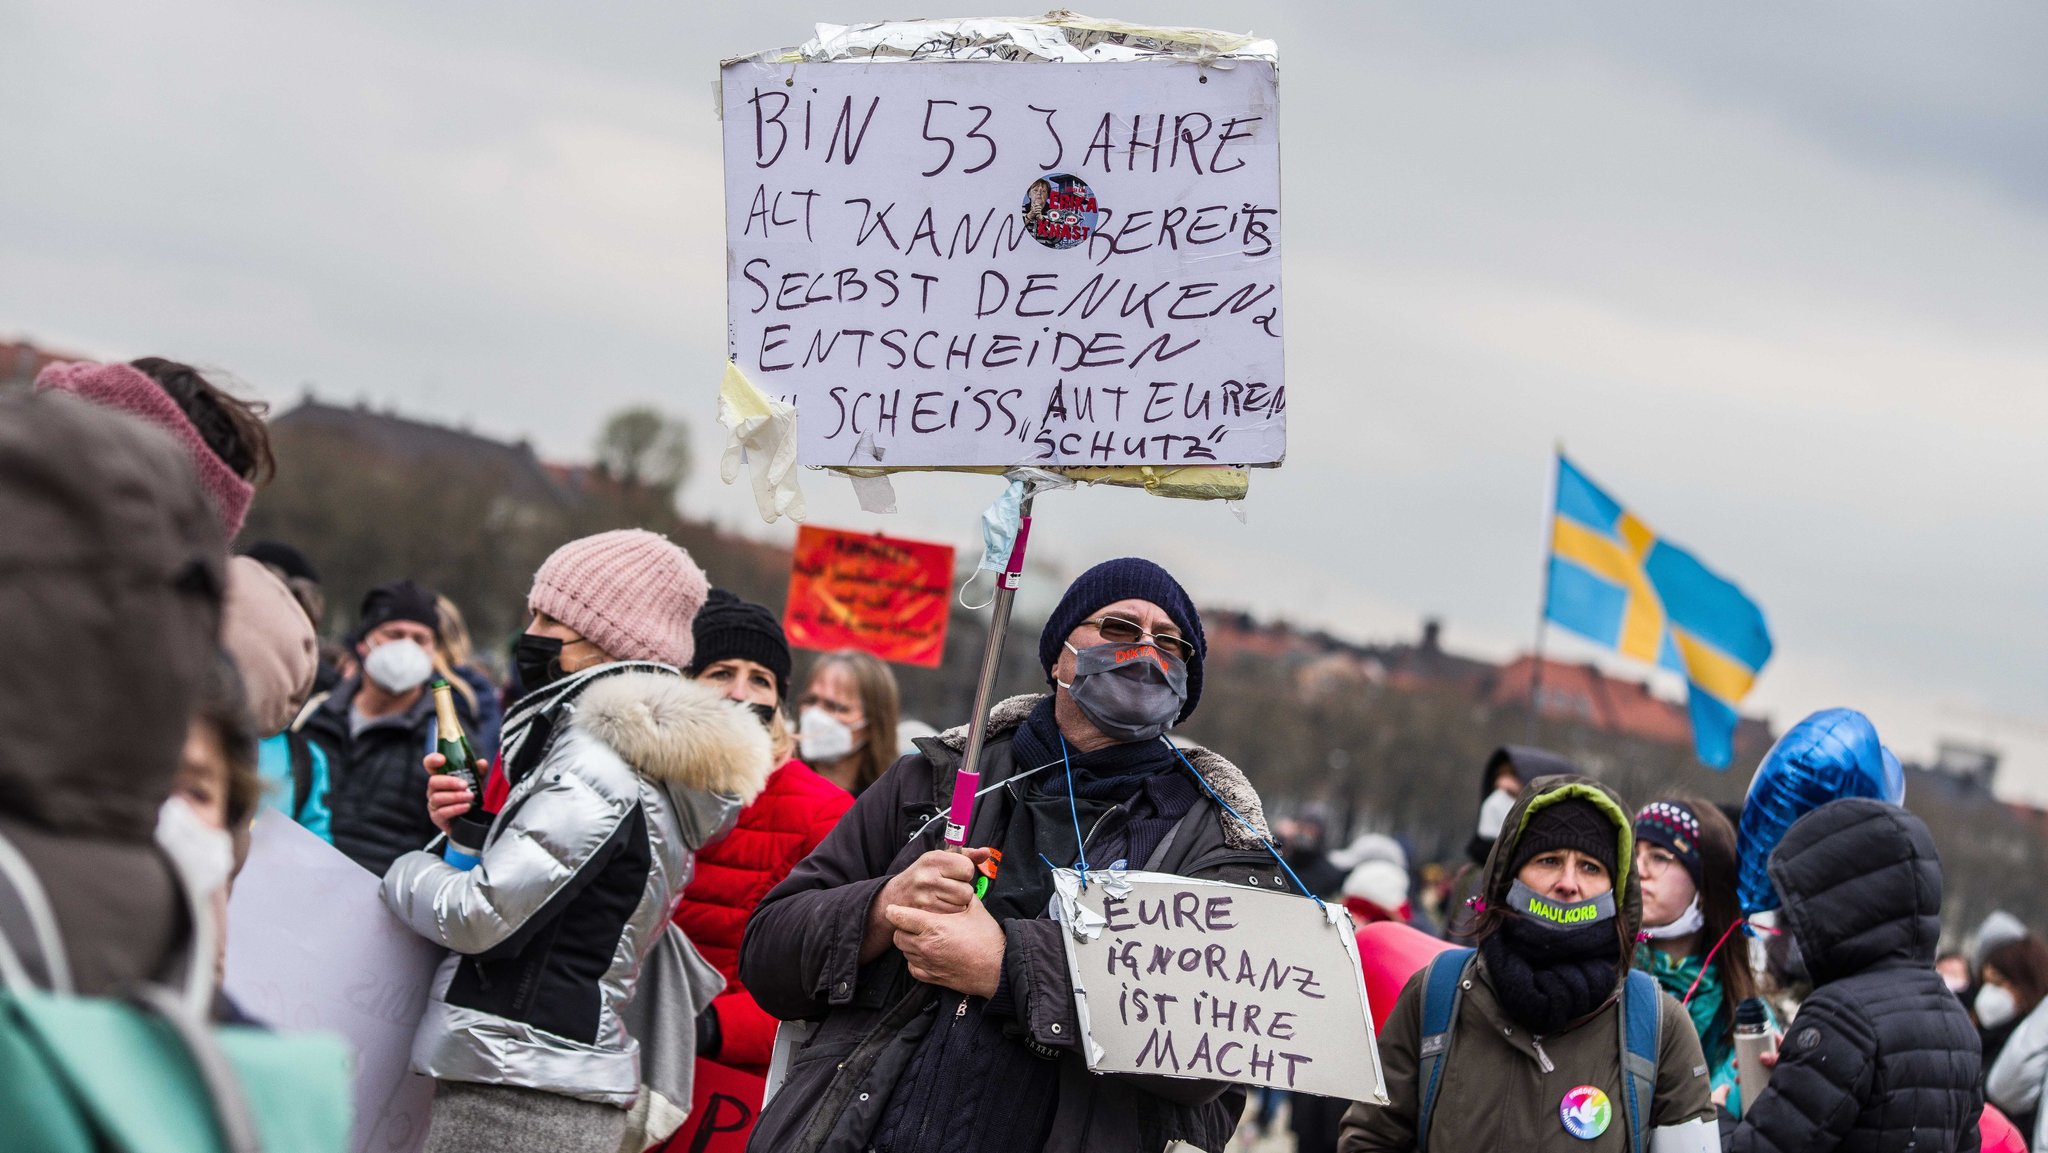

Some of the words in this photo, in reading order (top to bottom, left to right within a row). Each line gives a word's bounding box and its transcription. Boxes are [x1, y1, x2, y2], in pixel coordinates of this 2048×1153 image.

[922, 100, 996, 177] 53
[1028, 104, 1262, 176] JAHRE
[745, 183, 820, 242] ALT
[845, 198, 1027, 260] KANN
[1049, 191, 1098, 213] ERIKA
[1037, 219, 1089, 240] KNAST
[744, 258, 938, 313] SELBST
[976, 270, 1275, 328] DENKEN
[1103, 891, 1238, 933] EURE
[1528, 898, 1597, 923] MAULKORB
[1135, 1028, 1313, 1088] MACHT
